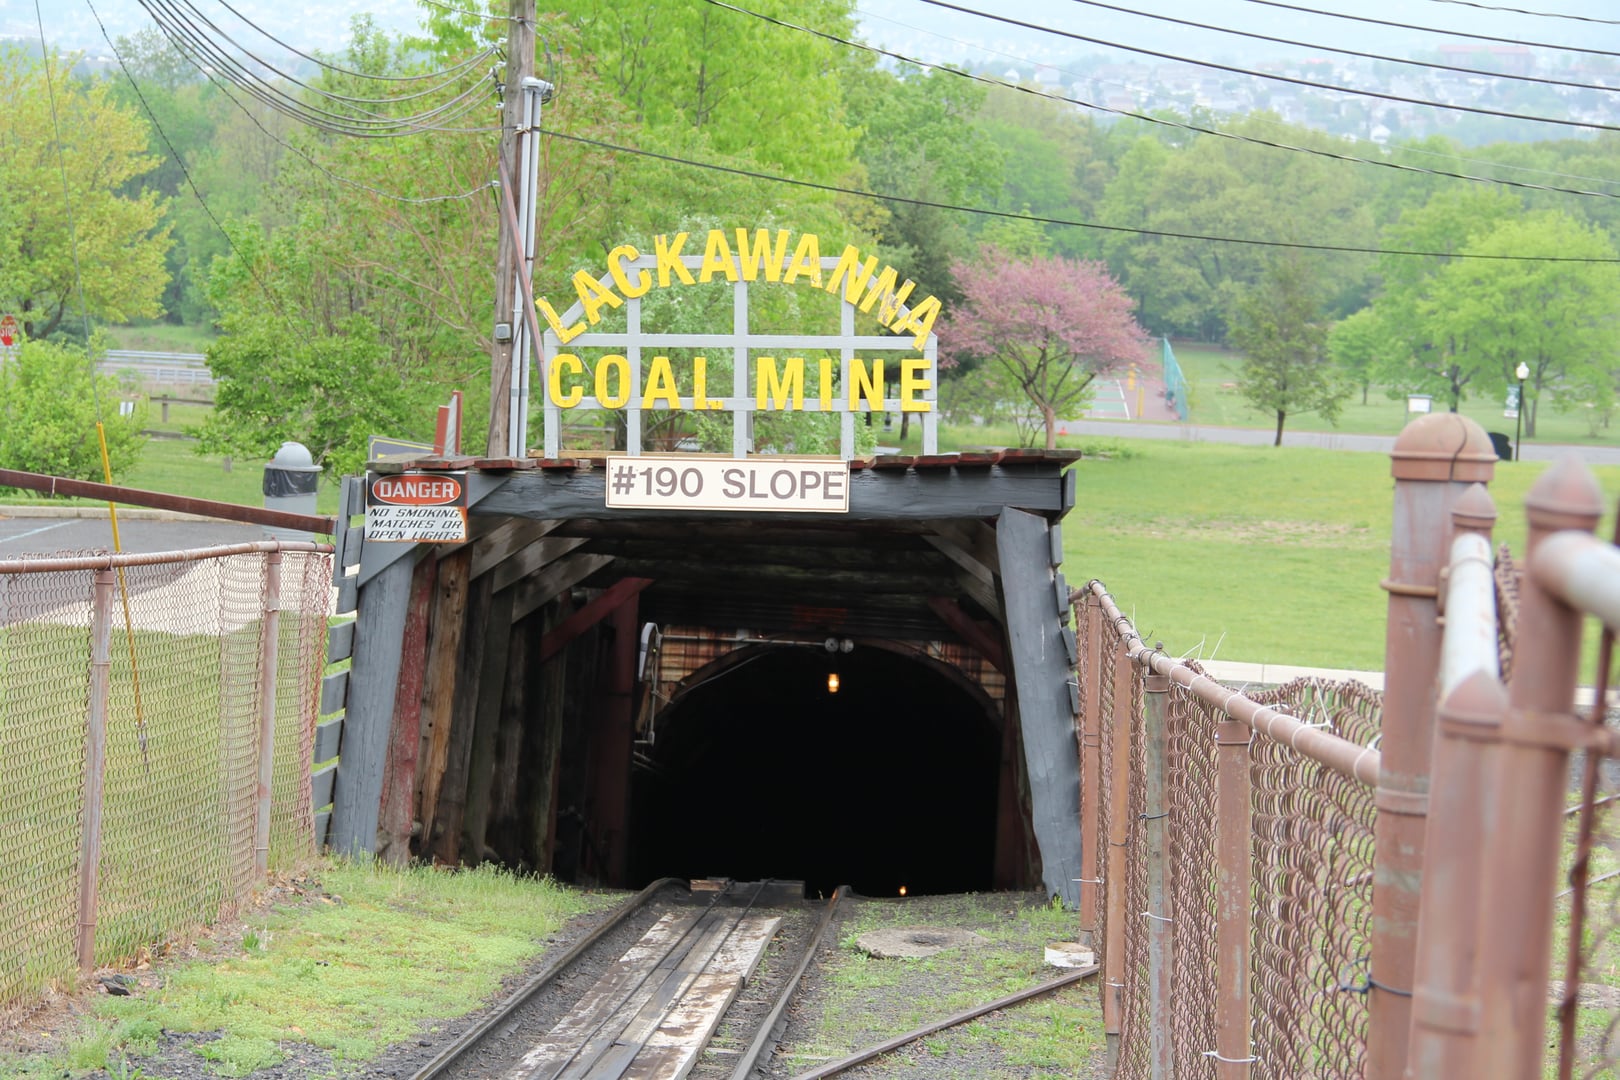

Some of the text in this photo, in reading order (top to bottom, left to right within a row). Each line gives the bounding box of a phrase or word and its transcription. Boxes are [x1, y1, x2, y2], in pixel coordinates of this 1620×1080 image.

[535, 228, 942, 352] LACKAWANNA
[548, 354, 932, 412] COAL MINE
[380, 481, 455, 499] DANGER
[612, 465, 844, 500] #190 SLOPE
[370, 508, 461, 518] NO SMOKING
[371, 519, 463, 529] MATCHES OR
[369, 530, 461, 540] OPEN LIGHTS
